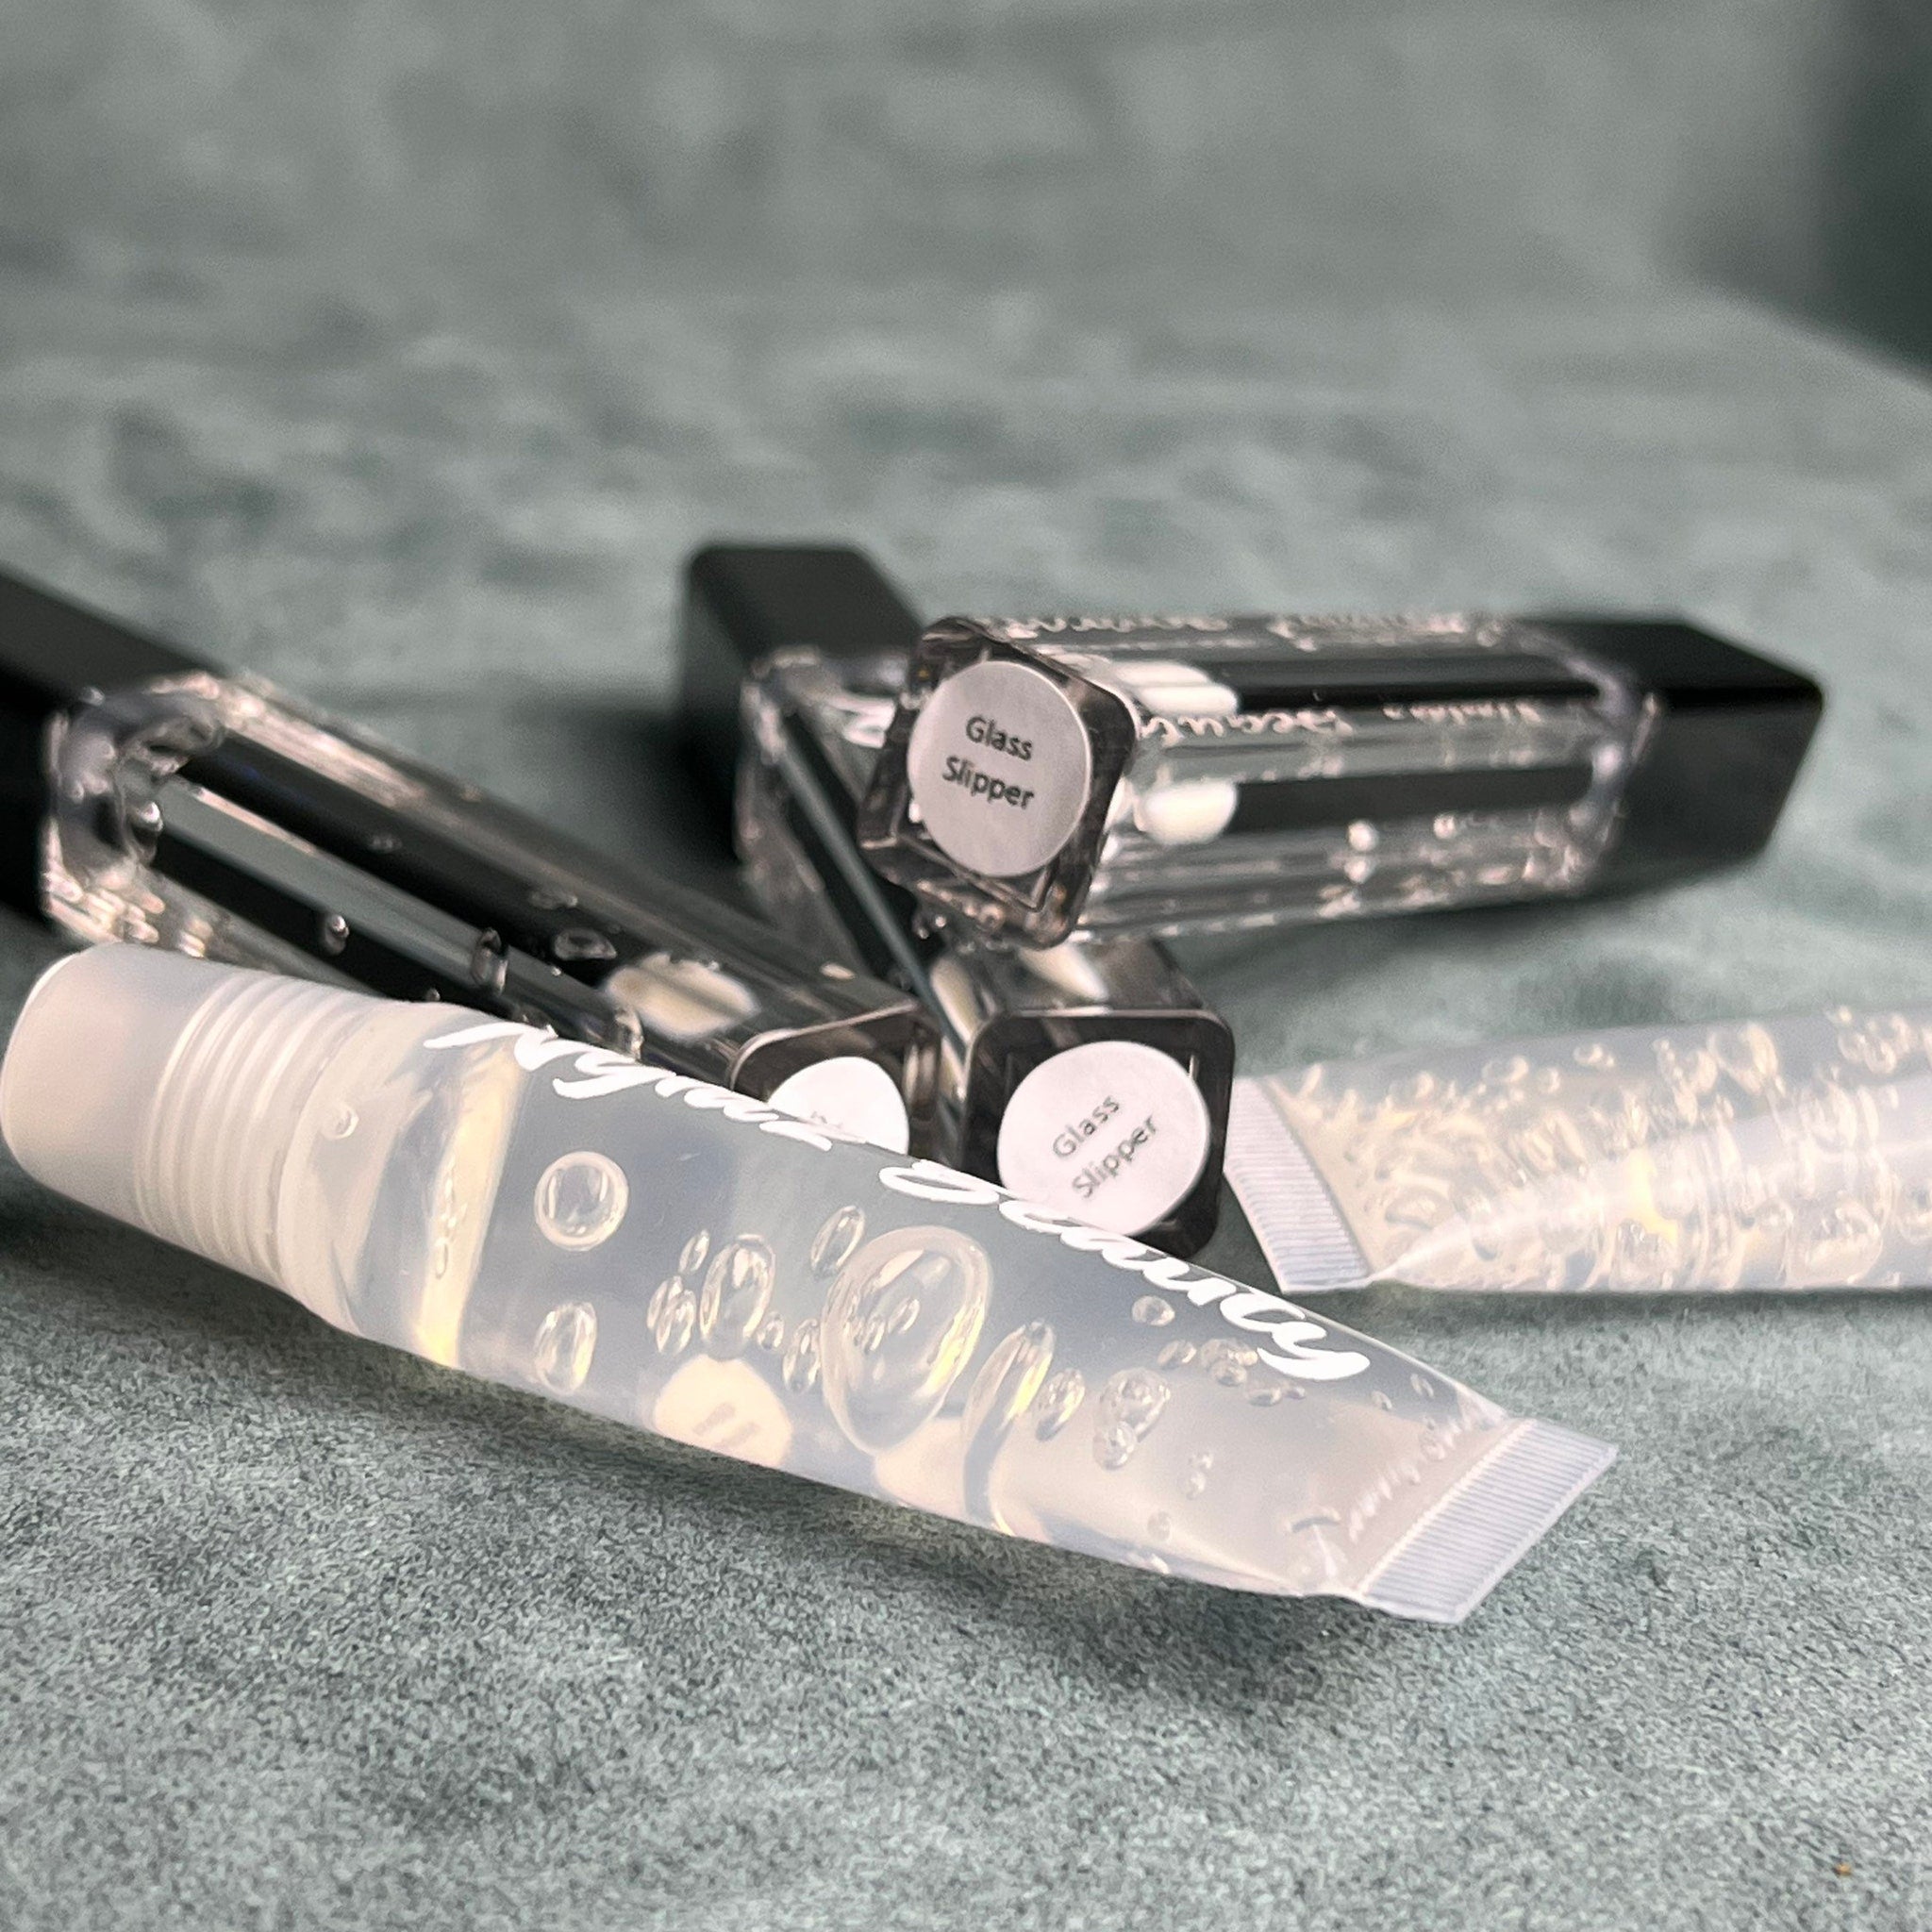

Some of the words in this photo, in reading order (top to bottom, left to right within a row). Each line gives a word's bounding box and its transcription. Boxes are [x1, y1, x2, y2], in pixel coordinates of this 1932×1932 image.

[966, 715, 1032, 760] Glass
[941, 756, 1034, 809] Slipper
[1052, 1095, 1120, 1158] Glass
[1072, 1114, 1156, 1199] Slipper
[878, 1158, 1371, 1381] Beauty
